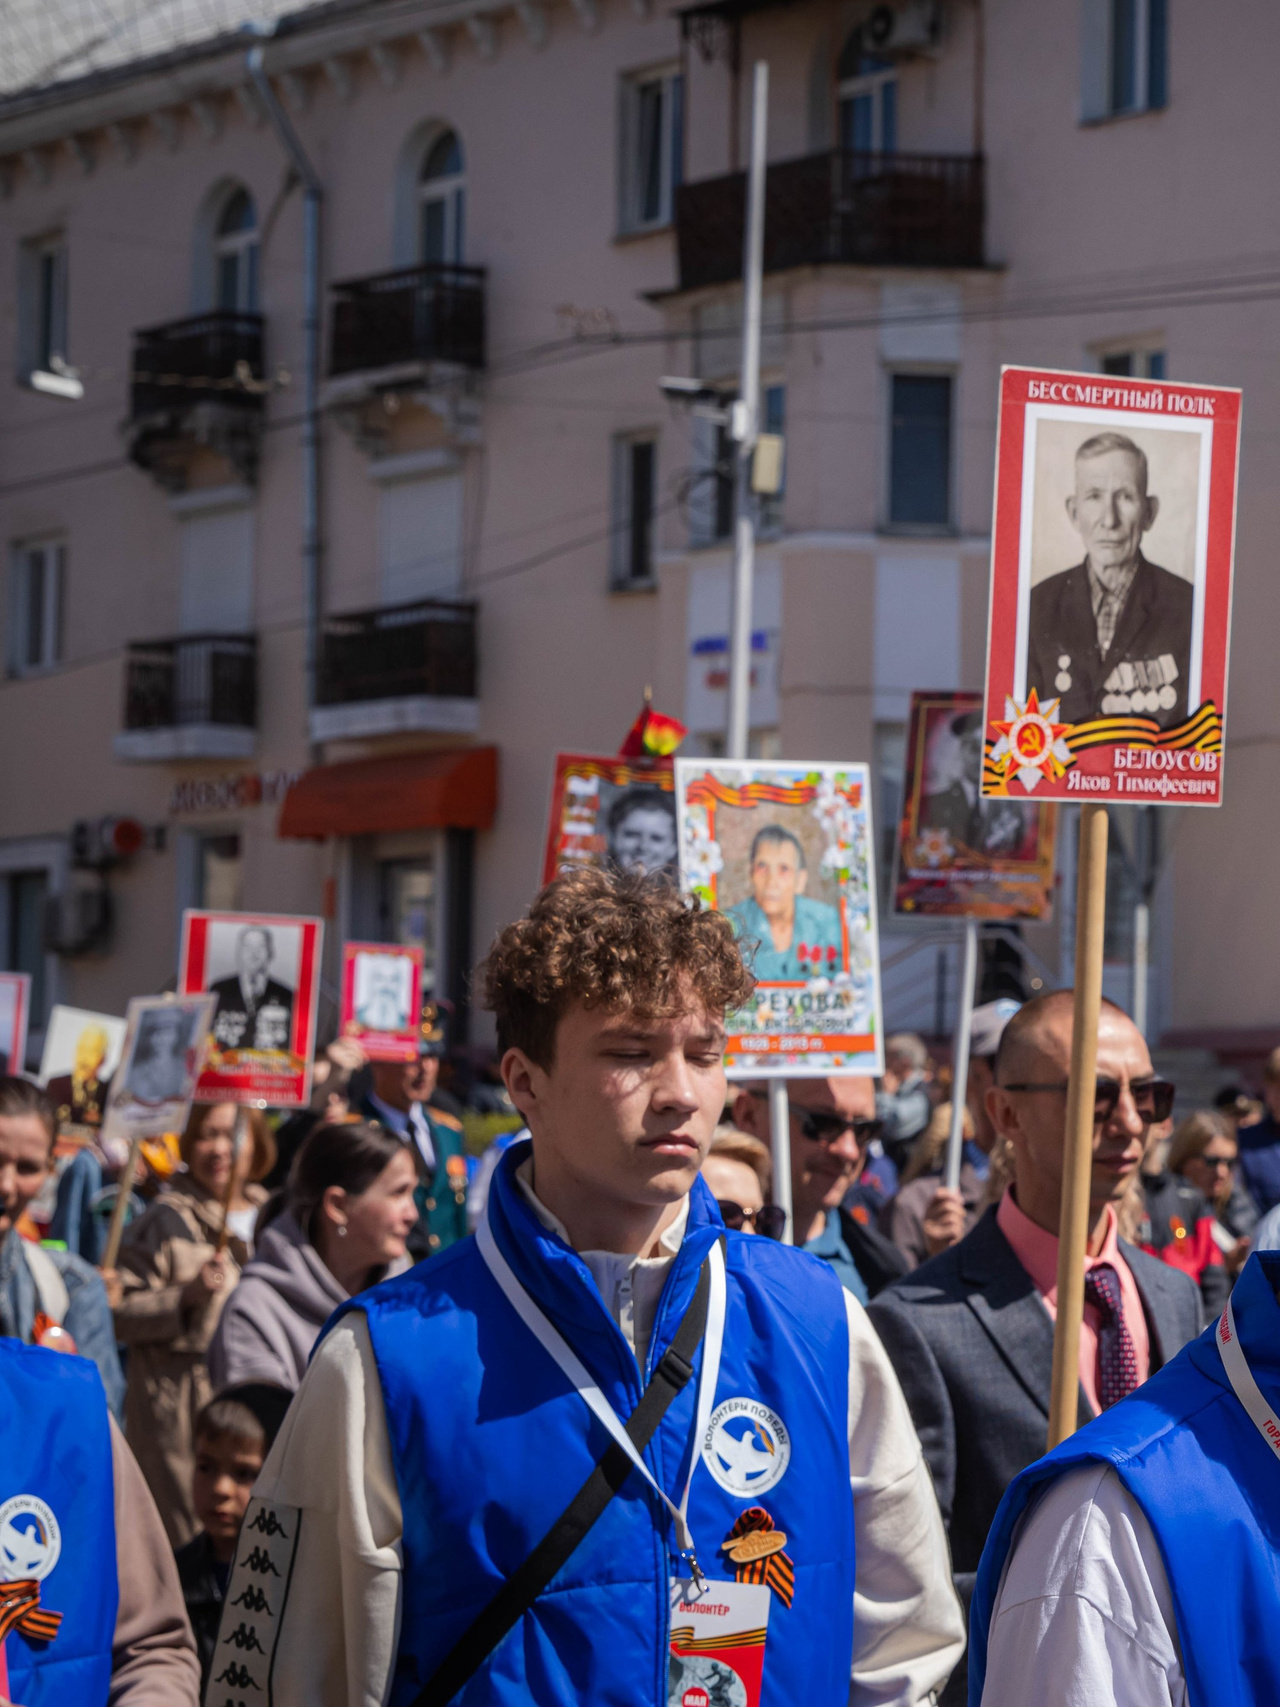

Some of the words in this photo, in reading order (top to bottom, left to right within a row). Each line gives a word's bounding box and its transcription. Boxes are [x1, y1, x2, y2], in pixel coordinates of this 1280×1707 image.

[1028, 379, 1163, 411] БЕССМЕРТНЫЙ
[1167, 392, 1216, 416] ПОЛК
[1114, 747, 1218, 772] БЕЛОУСОВ
[1067, 770, 1111, 791] Яков
[1116, 771, 1217, 797] Тимофеевич
[751, 1404, 788, 1445] ПОБЕДЫ
